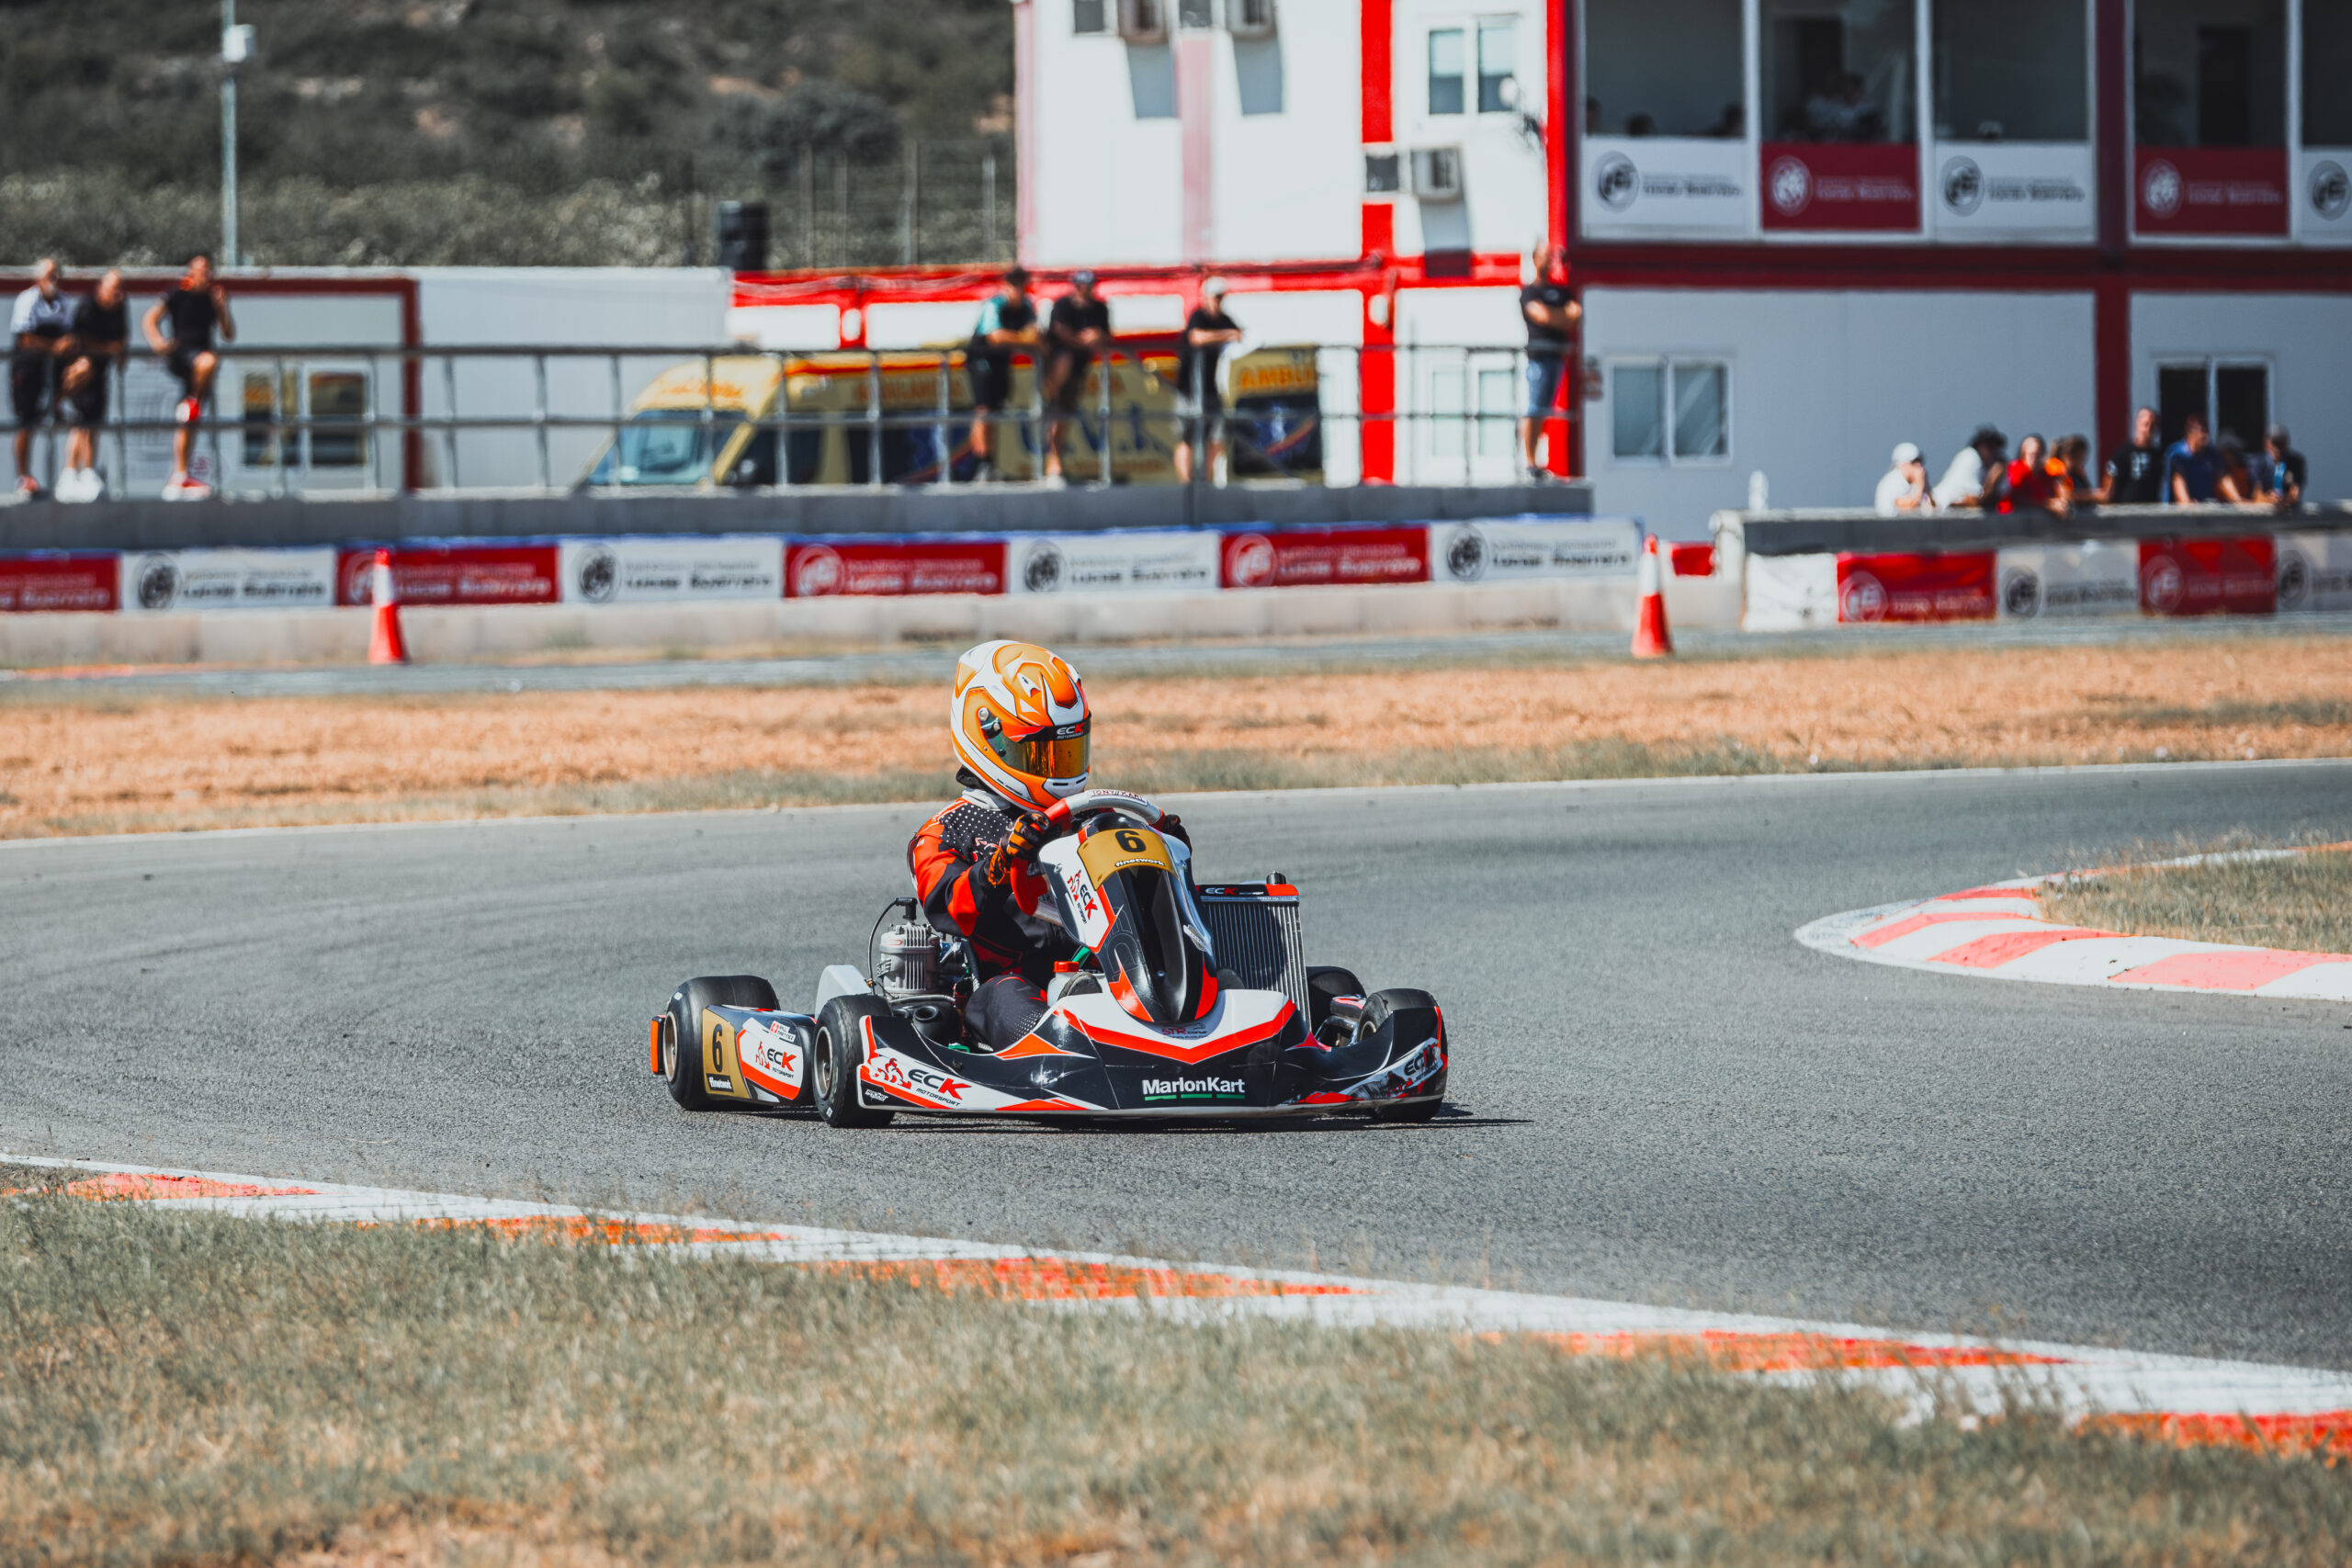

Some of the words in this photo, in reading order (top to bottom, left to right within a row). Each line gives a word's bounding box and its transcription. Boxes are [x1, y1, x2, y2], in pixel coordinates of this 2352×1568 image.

[1057, 722, 1085, 735] ECK
[1114, 829, 1147, 852] 6
[1080, 884, 1098, 920] ECK
[712, 1023, 723, 1073] 6
[767, 1048, 797, 1072] ECK
[908, 1068, 972, 1100] ECK
[1142, 1077, 1245, 1094] MarlonKart
[916, 1088, 961, 1107] MOTORSPORT
